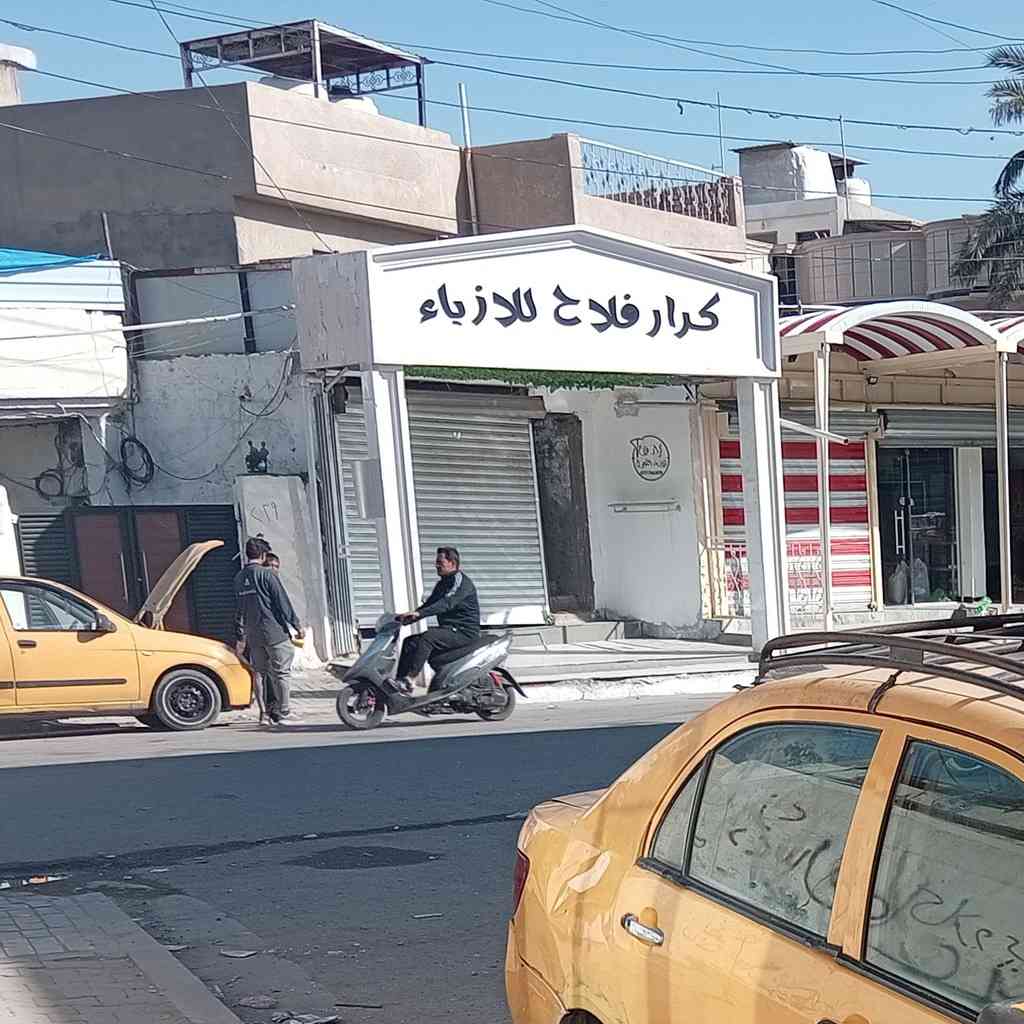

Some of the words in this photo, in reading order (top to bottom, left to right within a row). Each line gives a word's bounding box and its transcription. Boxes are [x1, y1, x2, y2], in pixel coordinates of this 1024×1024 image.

[419, 283, 538, 328] للازياء
[552, 284, 640, 333] فلاح
[645, 291, 721, 339] كرار
